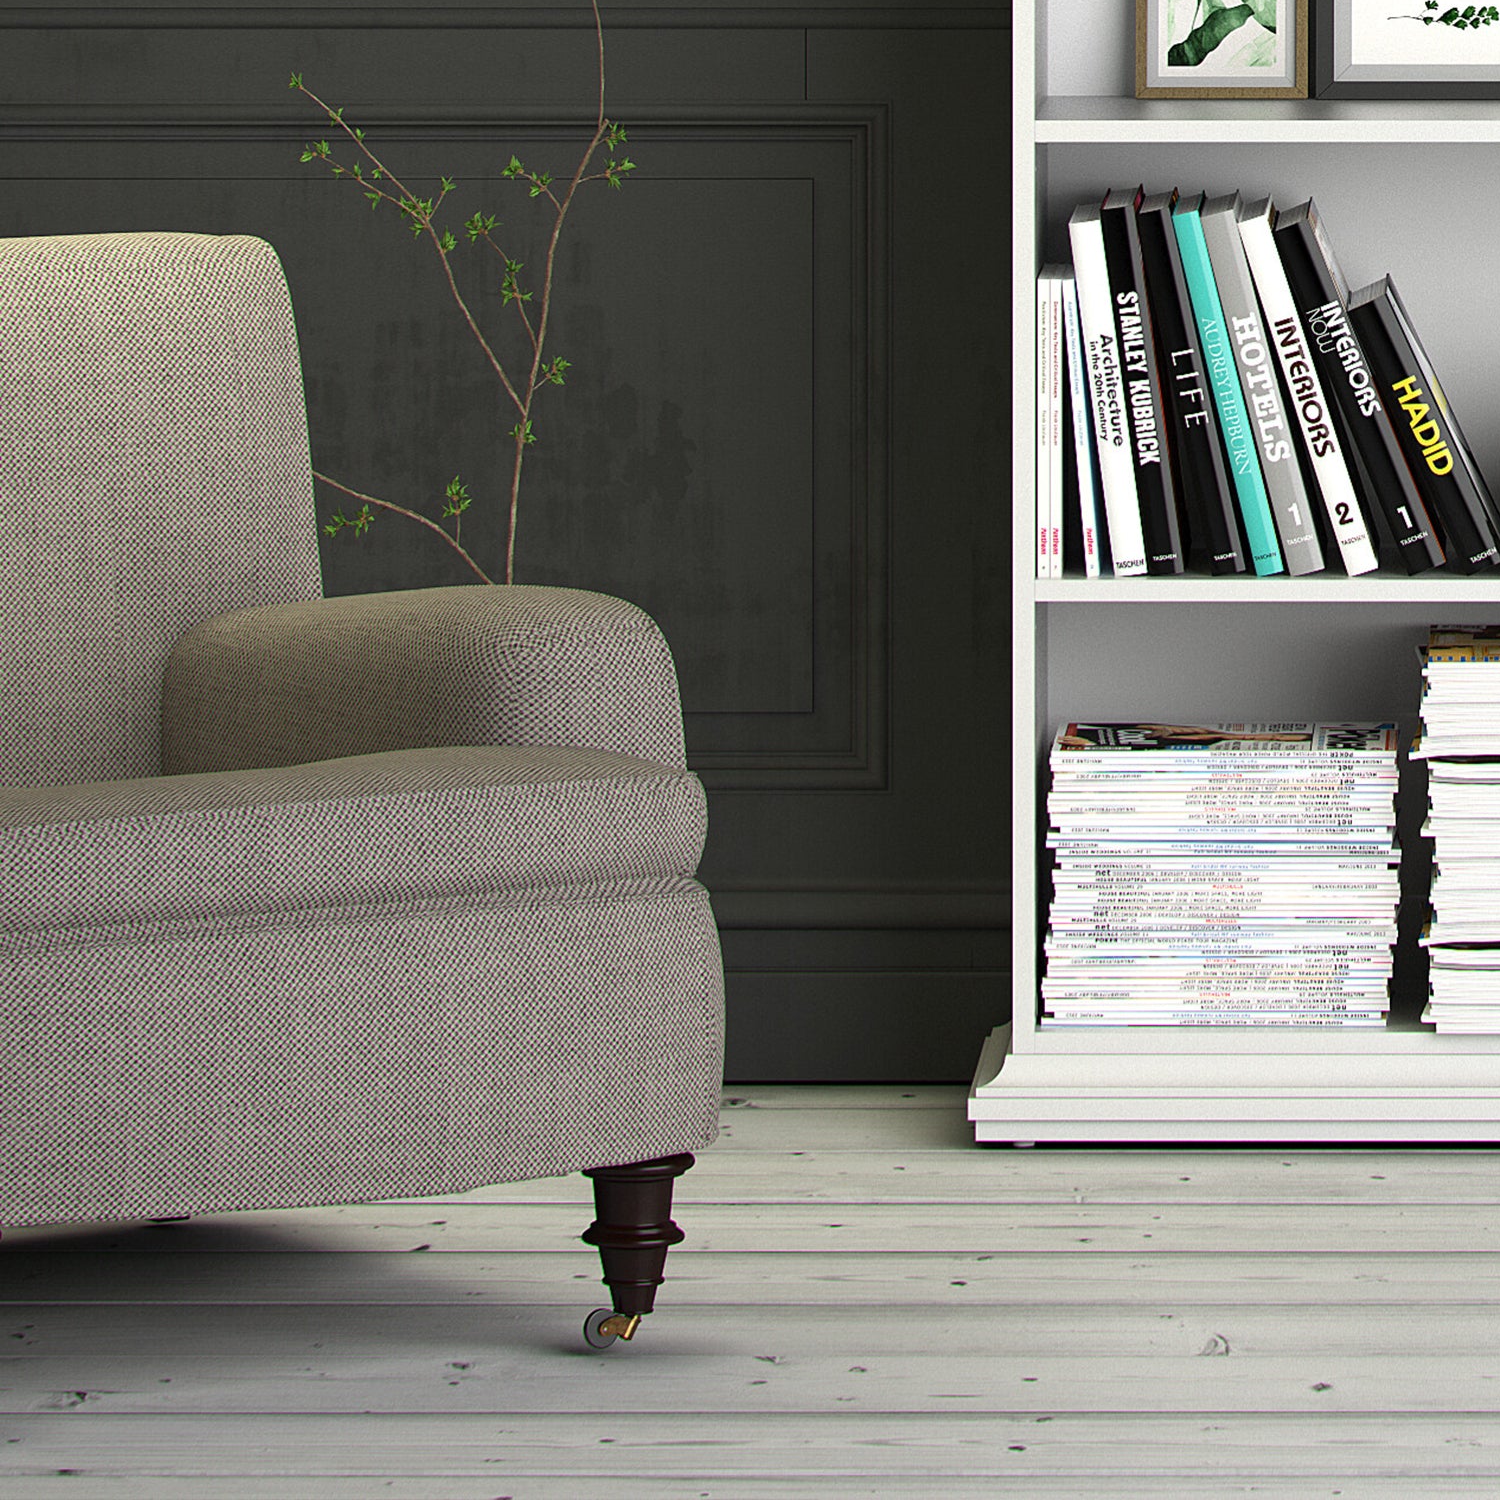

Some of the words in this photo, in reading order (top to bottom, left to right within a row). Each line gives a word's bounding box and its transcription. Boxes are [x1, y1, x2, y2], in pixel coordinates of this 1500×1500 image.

[1116, 290, 1149, 373] STANLEY
[1306, 307, 1336, 354] NOW
[1089, 340, 1097, 350] in
[1091, 353, 1099, 370] the
[1320, 300, 1382, 418] INTERIORS
[1094, 374, 1104, 398] 20th
[1100, 334, 1123, 447] Architecture
[1171, 348, 1210, 429] LIFE
[1201, 318, 1232, 388] AUDREY
[1219, 387, 1252, 476] HEPBURN
[1231, 312, 1292, 463] HOTELS
[1274, 316, 1336, 458] INTERIORS
[1097, 399, 1109, 442] Century
[1128, 379, 1161, 467] KUBRICK
[1391, 375, 1454, 476] HADID
[1287, 502, 1302, 526] 1
[1335, 501, 1354, 526] 2
[1397, 505, 1414, 529] 1
[1286, 533, 1314, 546] TASCHEN
[1340, 534, 1367, 546] TASCHEN
[1400, 531, 1429, 546] TASCHEN
[1116, 558, 1145, 570] TASCHEN
[1152, 553, 1178, 562] TASCHEN
[1254, 552, 1277, 562] TASCHEN
[1470, 546, 1498, 564] TASCHEN
